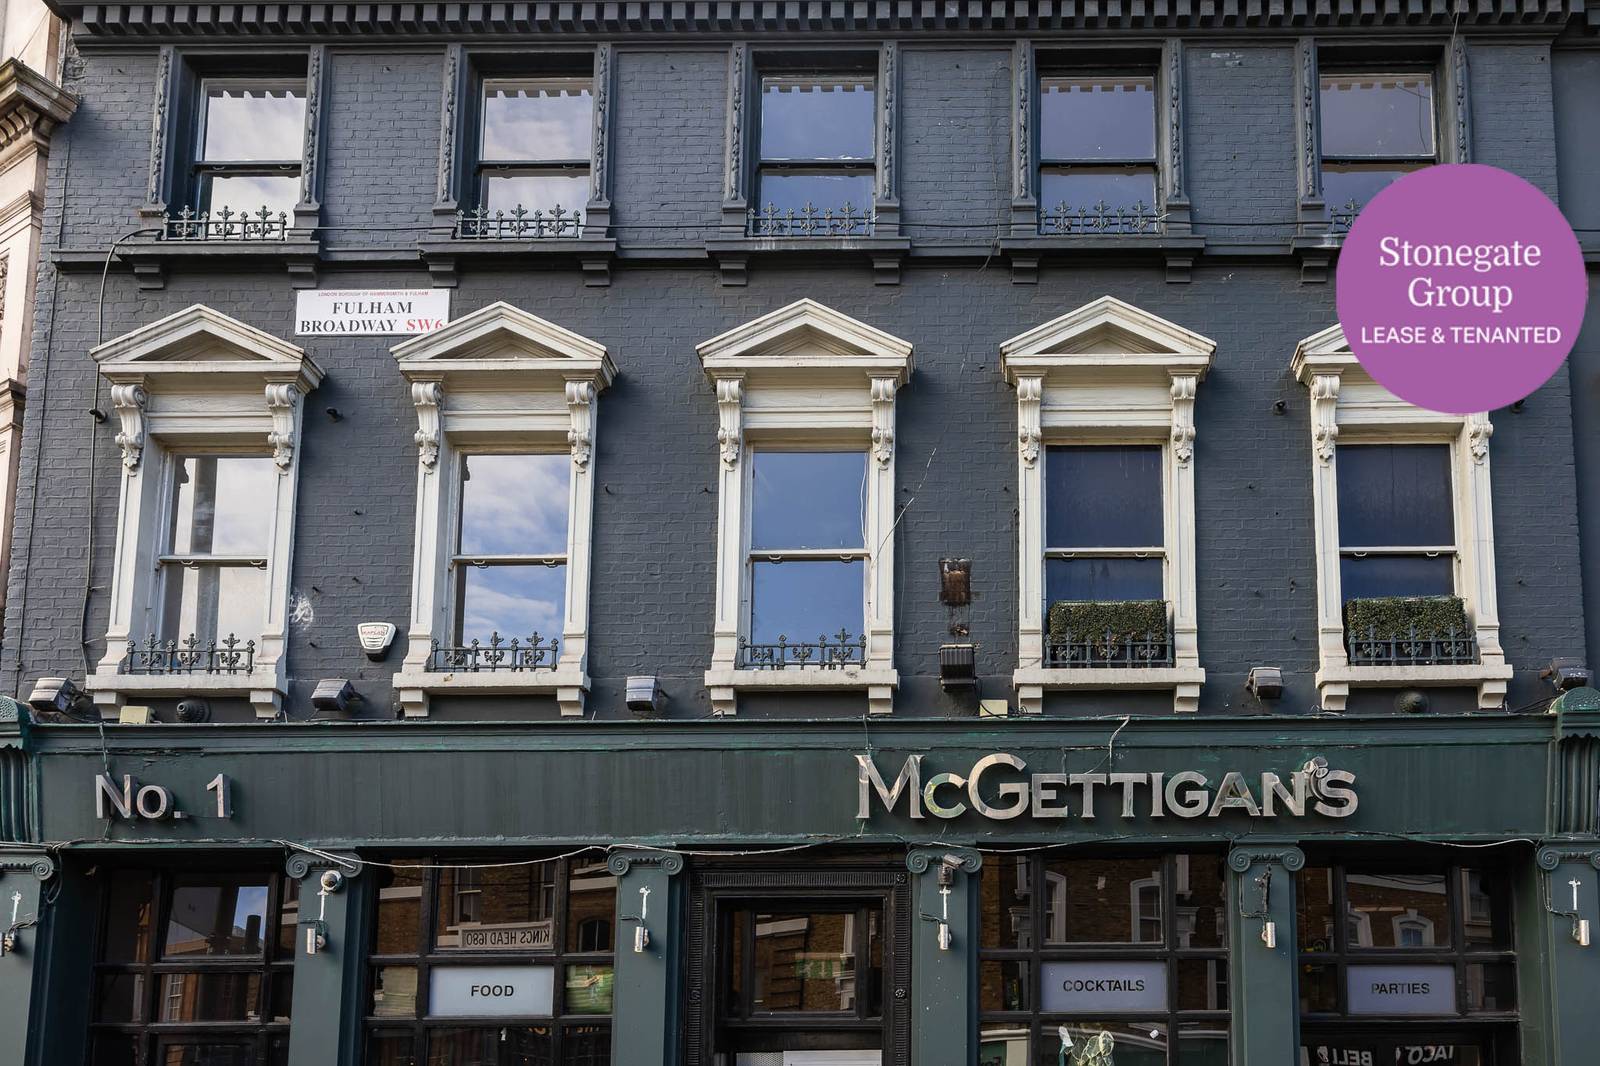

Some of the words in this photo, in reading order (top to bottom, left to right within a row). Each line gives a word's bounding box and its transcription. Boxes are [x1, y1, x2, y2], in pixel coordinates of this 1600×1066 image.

[332, 301, 413, 314] FULHAM
[300, 319, 397, 333] BROADWAY
[95, 774, 189, 820] No.
[206, 773, 231, 819] 1
[471, 984, 515, 997] FOOD
[1063, 980, 1145, 992] COCKTAILS
[1371, 982, 1430, 994] PARTIES
